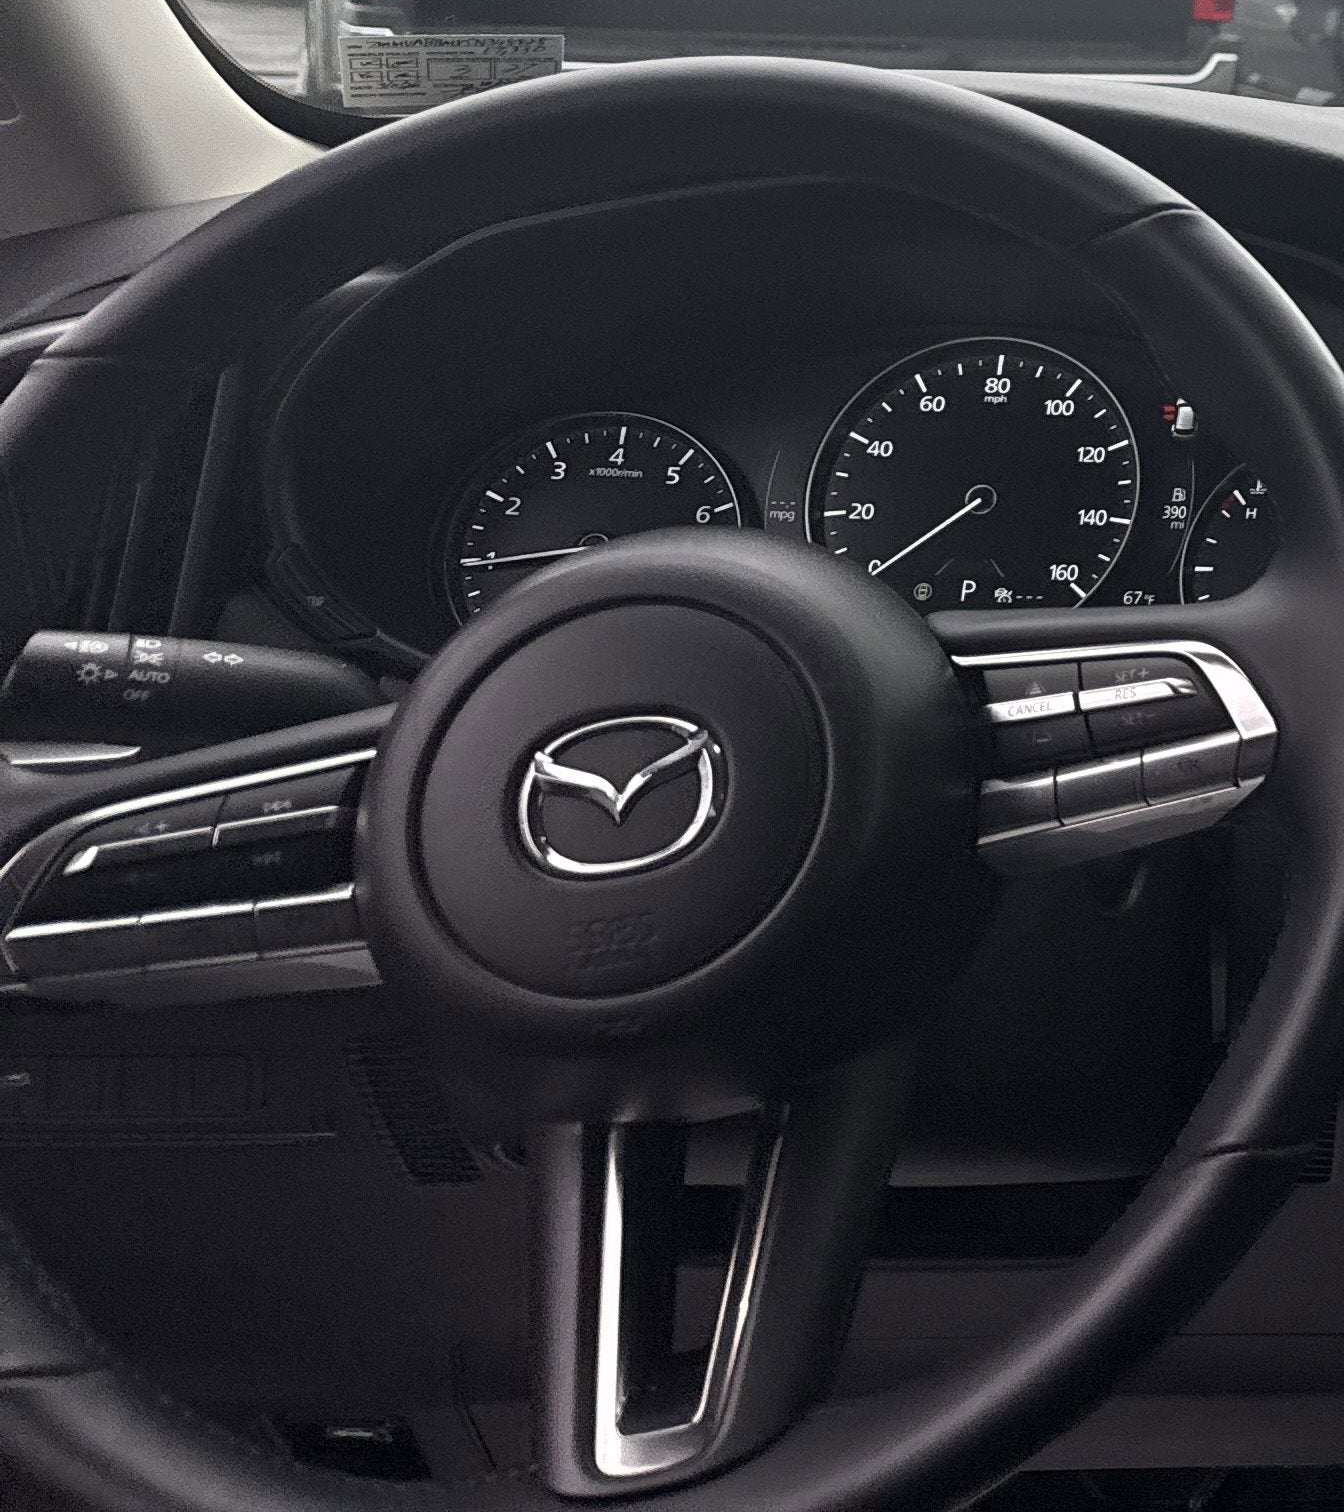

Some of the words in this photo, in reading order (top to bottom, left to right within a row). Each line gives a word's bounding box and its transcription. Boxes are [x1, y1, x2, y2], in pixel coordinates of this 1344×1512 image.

[984, 377, 1011, 394] 80
[919, 395, 946, 413] 60
[984, 394, 1008, 404] mph
[1044, 399, 1075, 417] 100
[608, 447, 625, 466] 4
[866, 440, 894, 457] 40
[1077, 446, 1106, 463] 120
[550, 461, 567, 481] 3
[665, 466, 681, 485] 5
[504, 496, 522, 516] 2
[695, 505, 712, 524] 6
[848, 502, 875, 520] 20
[1162, 505, 1187, 519] 390
[1245, 507, 1258, 520] H
[769, 510, 796, 522] mpg
[1078, 509, 1107, 525] 140
[1170, 520, 1185, 530] mi
[1049, 564, 1079, 581] 160
[961, 580, 977, 602] P
[128, 669, 170, 684] AUTO
[1115, 687, 1137, 700] RES
[1008, 701, 1053, 717] CANCEL
